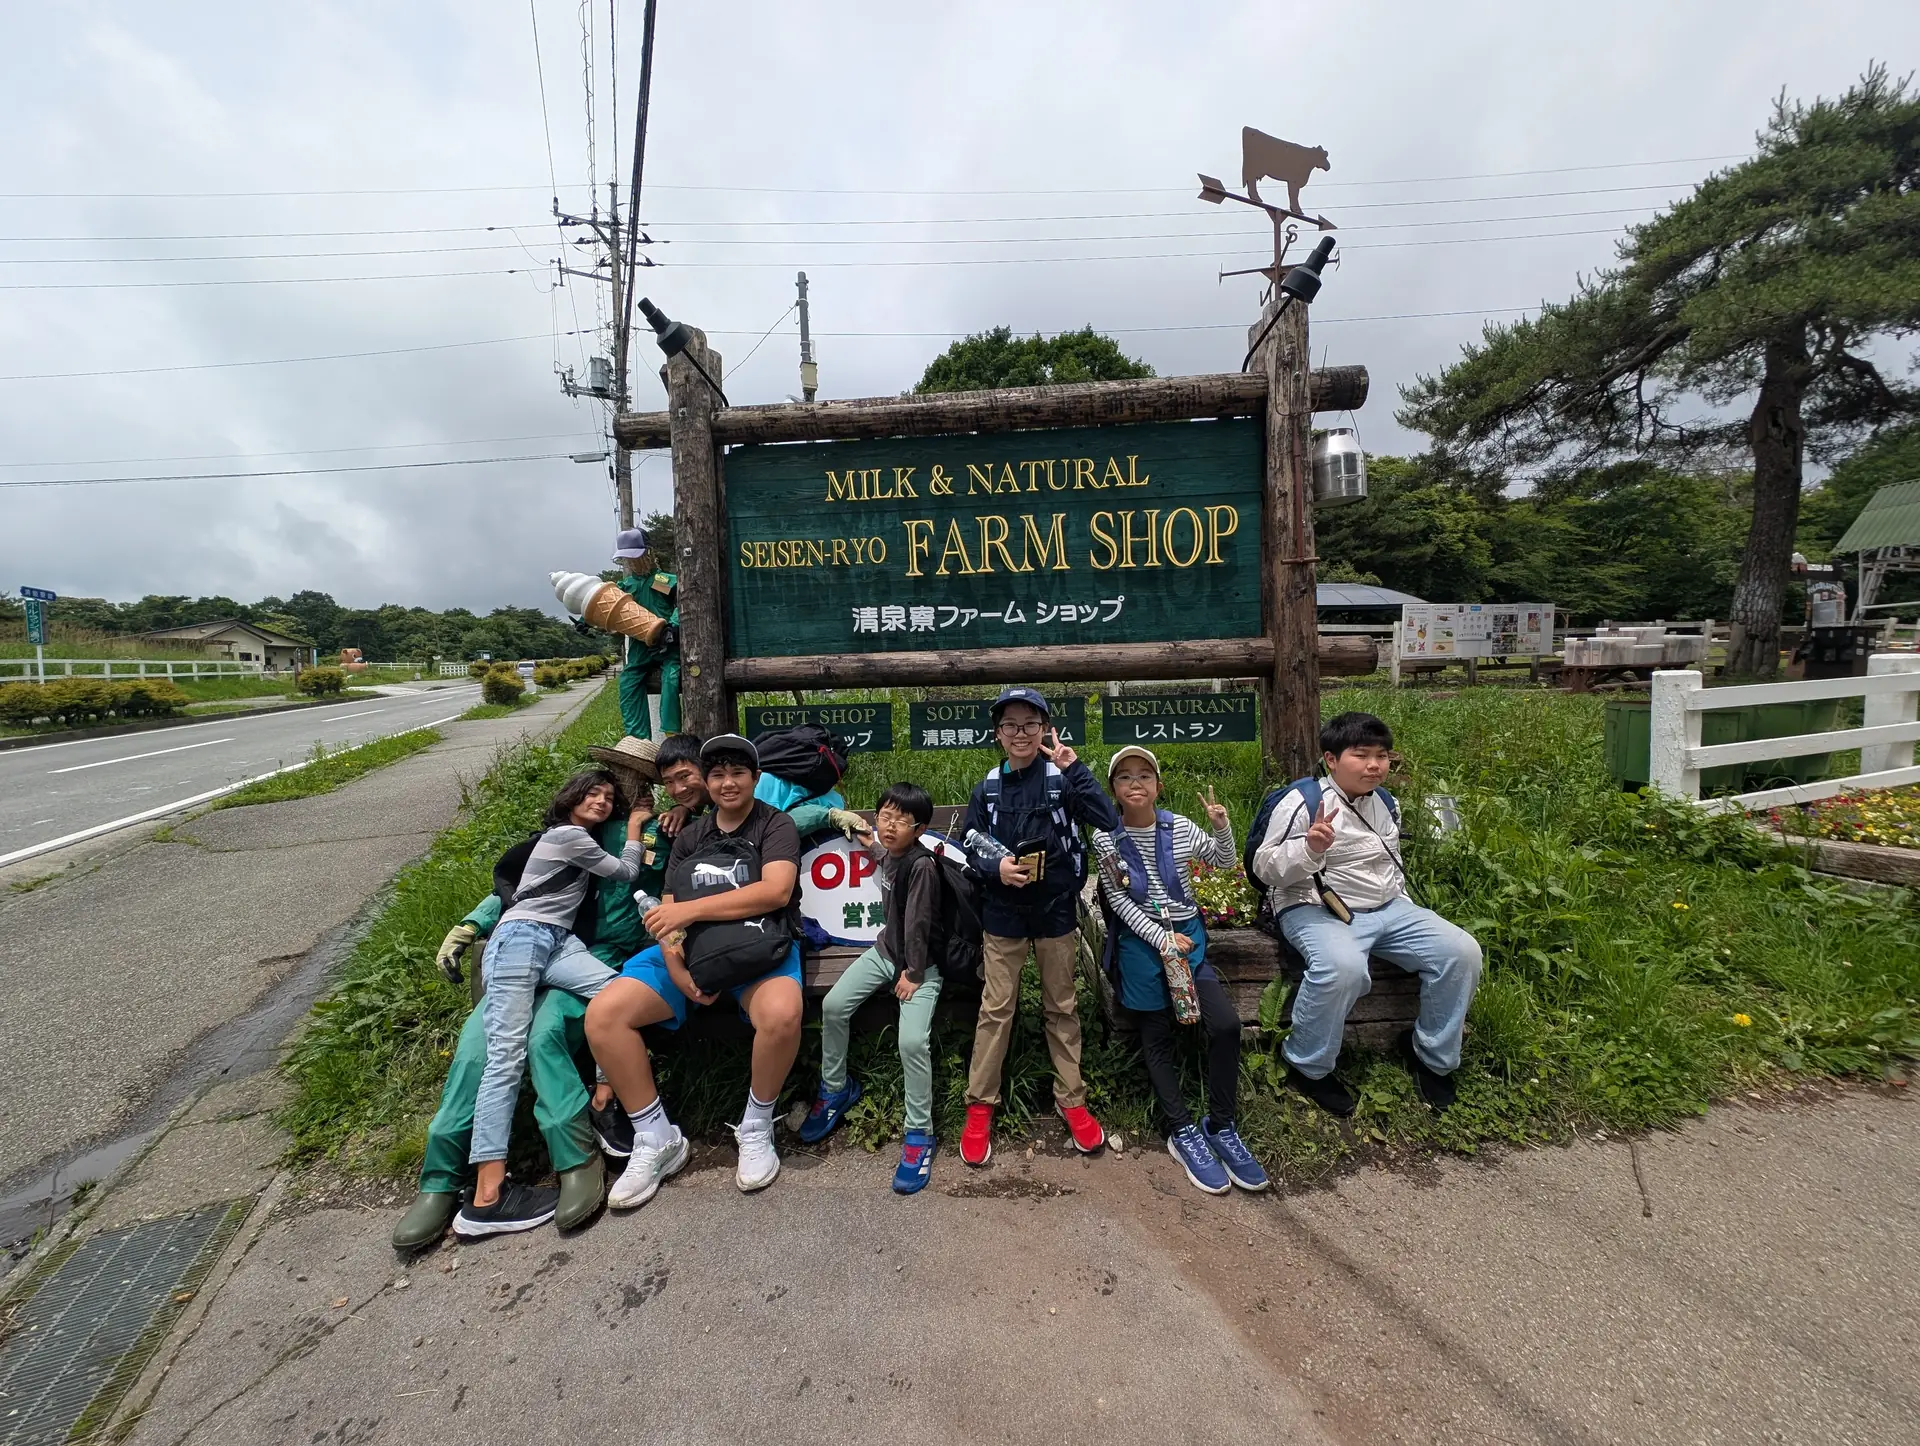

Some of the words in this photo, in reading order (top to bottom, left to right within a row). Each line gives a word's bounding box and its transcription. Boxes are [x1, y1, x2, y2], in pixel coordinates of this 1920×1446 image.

[825, 467, 918, 501] MILK
[929, 464, 953, 495] &
[967, 454, 1149, 495] NATURAL
[740, 536, 887, 568] SEISEN-RYO
[903, 513, 1071, 577] FARM
[1090, 504, 1239, 570] SHOP
[852, 601, 1026, 633] 清泉寮ファーム
[1036, 595, 1125, 624] ショップ
[760, 710, 810, 726] GIFT
[819, 708, 877, 724] SHOP
[926, 704, 980, 722] SOFT
[1110, 697, 1249, 717] RESTAURANT
[1135, 722, 1223, 739] レストラン
[811, 850, 877, 890] OP
[842, 902, 887, 929] 営業
